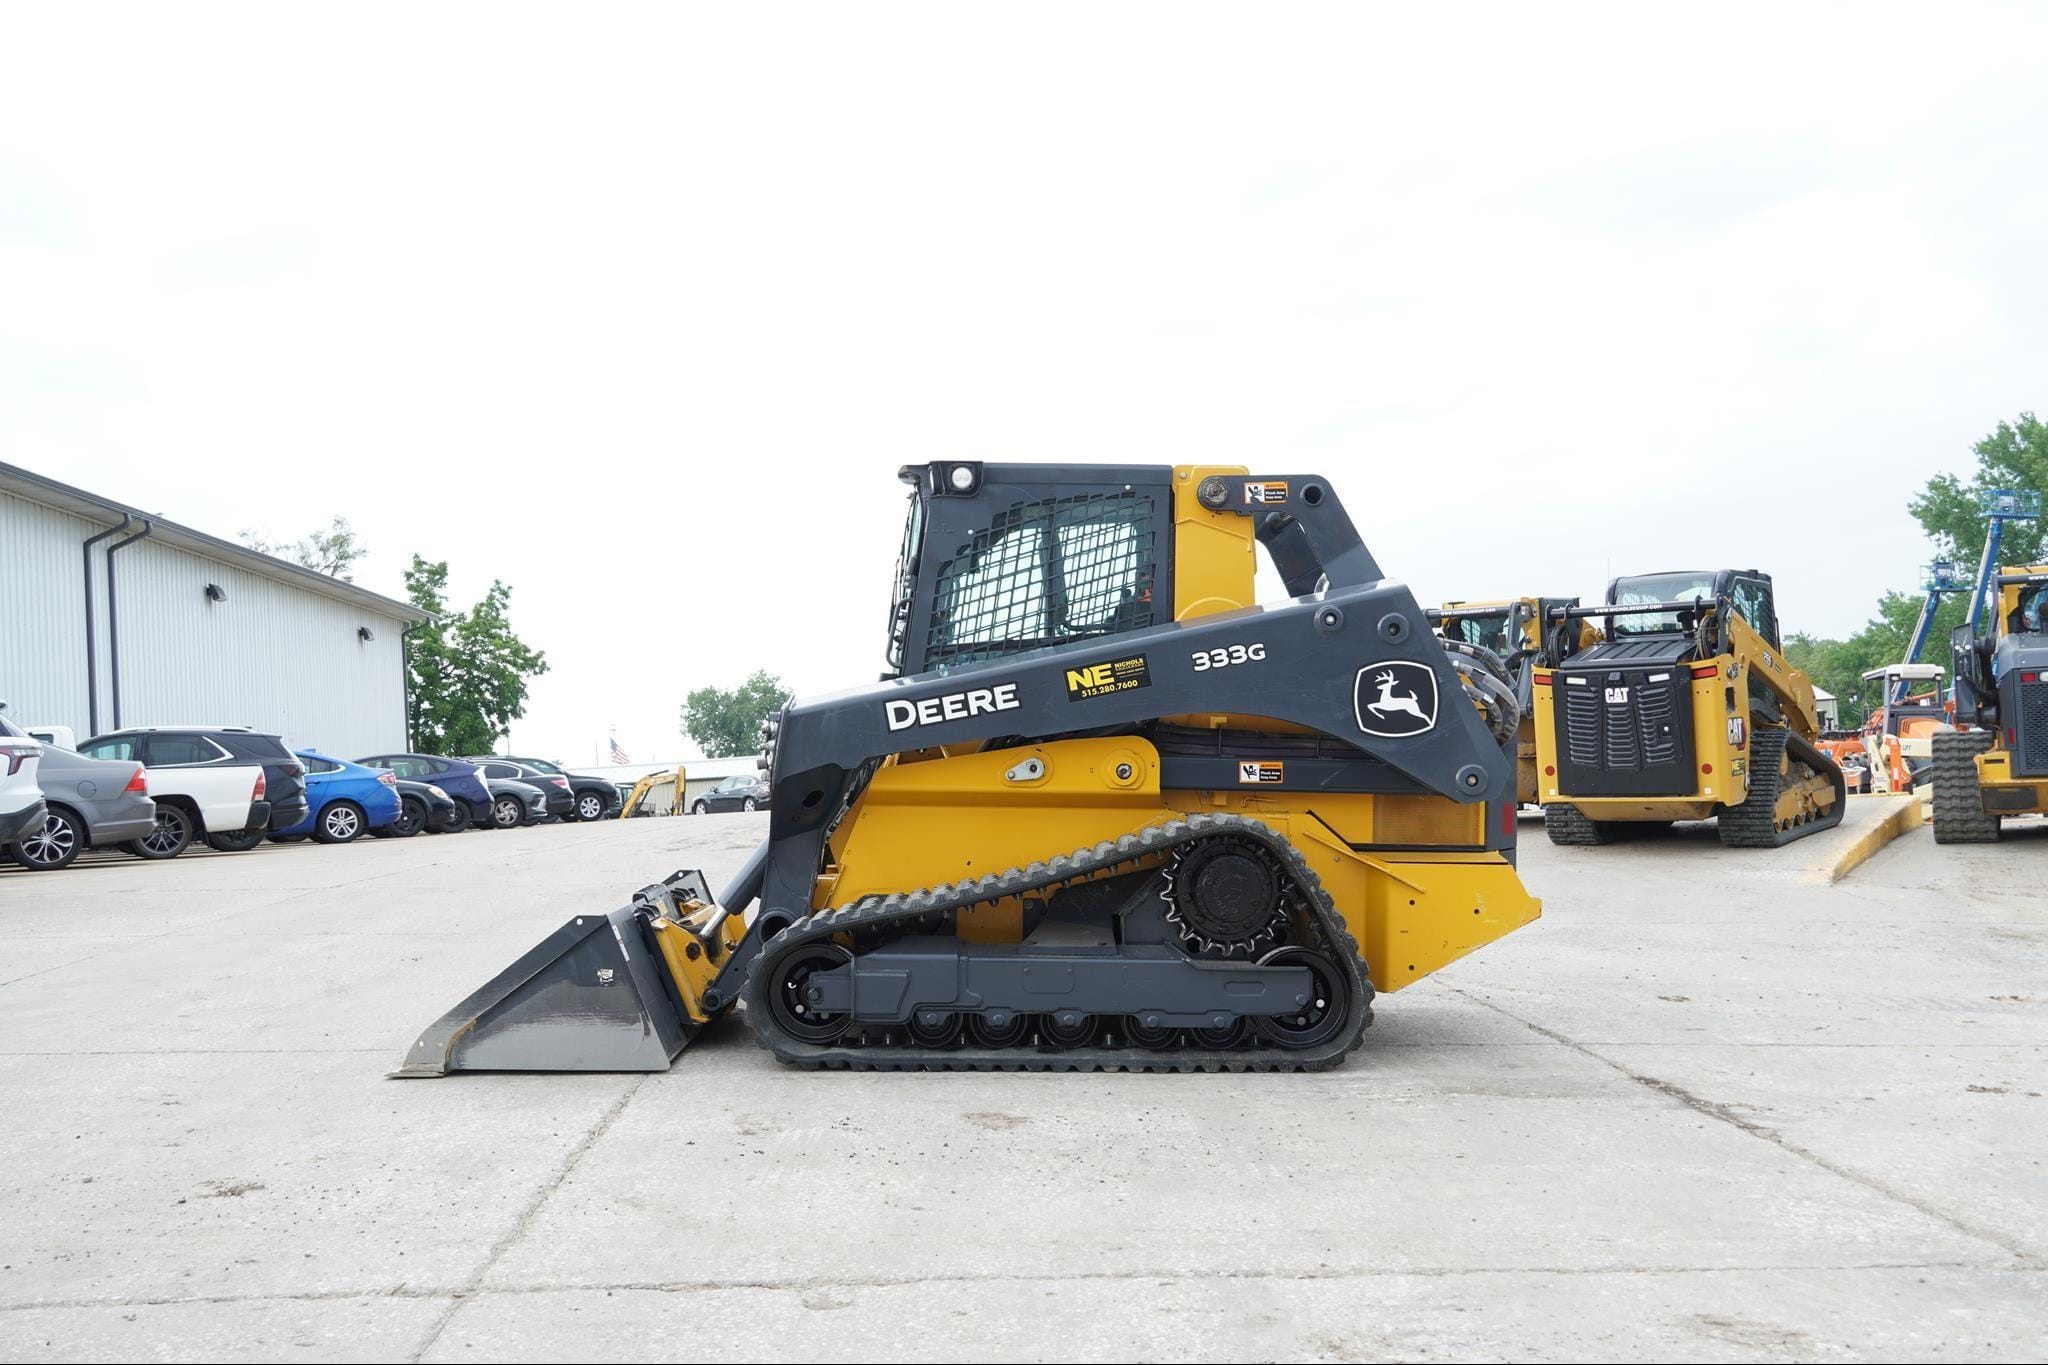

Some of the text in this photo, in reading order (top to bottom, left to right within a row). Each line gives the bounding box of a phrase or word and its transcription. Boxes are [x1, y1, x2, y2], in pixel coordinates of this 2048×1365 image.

[1114, 657, 1144, 669] NICHOLS
[1191, 643, 1266, 672] 333G
[1066, 663, 1115, 692] NE
[1081, 679, 1138, 698] 515.280.7600
[885, 683, 1020, 731] DEERE
[1604, 687, 1629, 704] CAT
[1727, 717, 1743, 745] CAT
